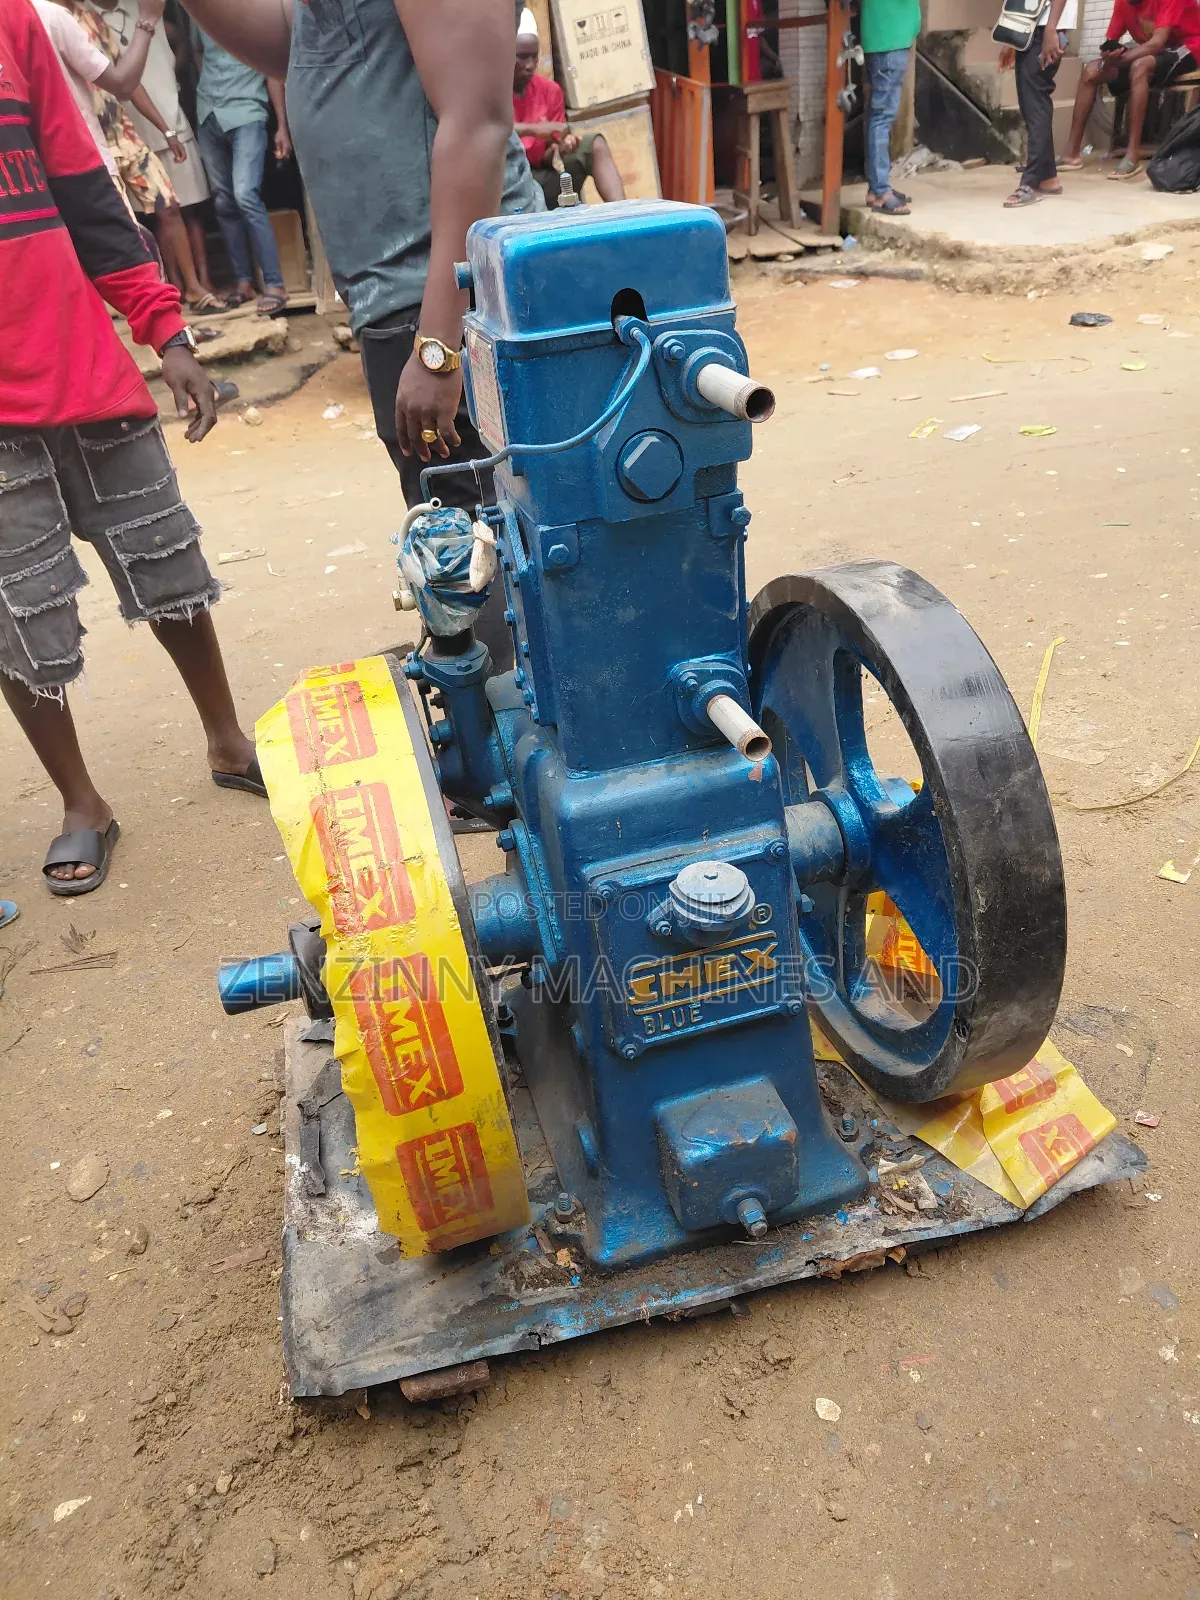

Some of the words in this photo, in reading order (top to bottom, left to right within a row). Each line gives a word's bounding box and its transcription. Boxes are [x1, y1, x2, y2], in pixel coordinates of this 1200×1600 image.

[310, 686, 352, 762] IMEX
[334, 790, 388, 923] IMEX
[627, 942, 779, 1005] IMEX
[373, 961, 437, 1105] IMEX
[643, 1002, 704, 1036] BLUE
[423, 1132, 467, 1220] IMEX
[1039, 1124, 1080, 1168] EX
